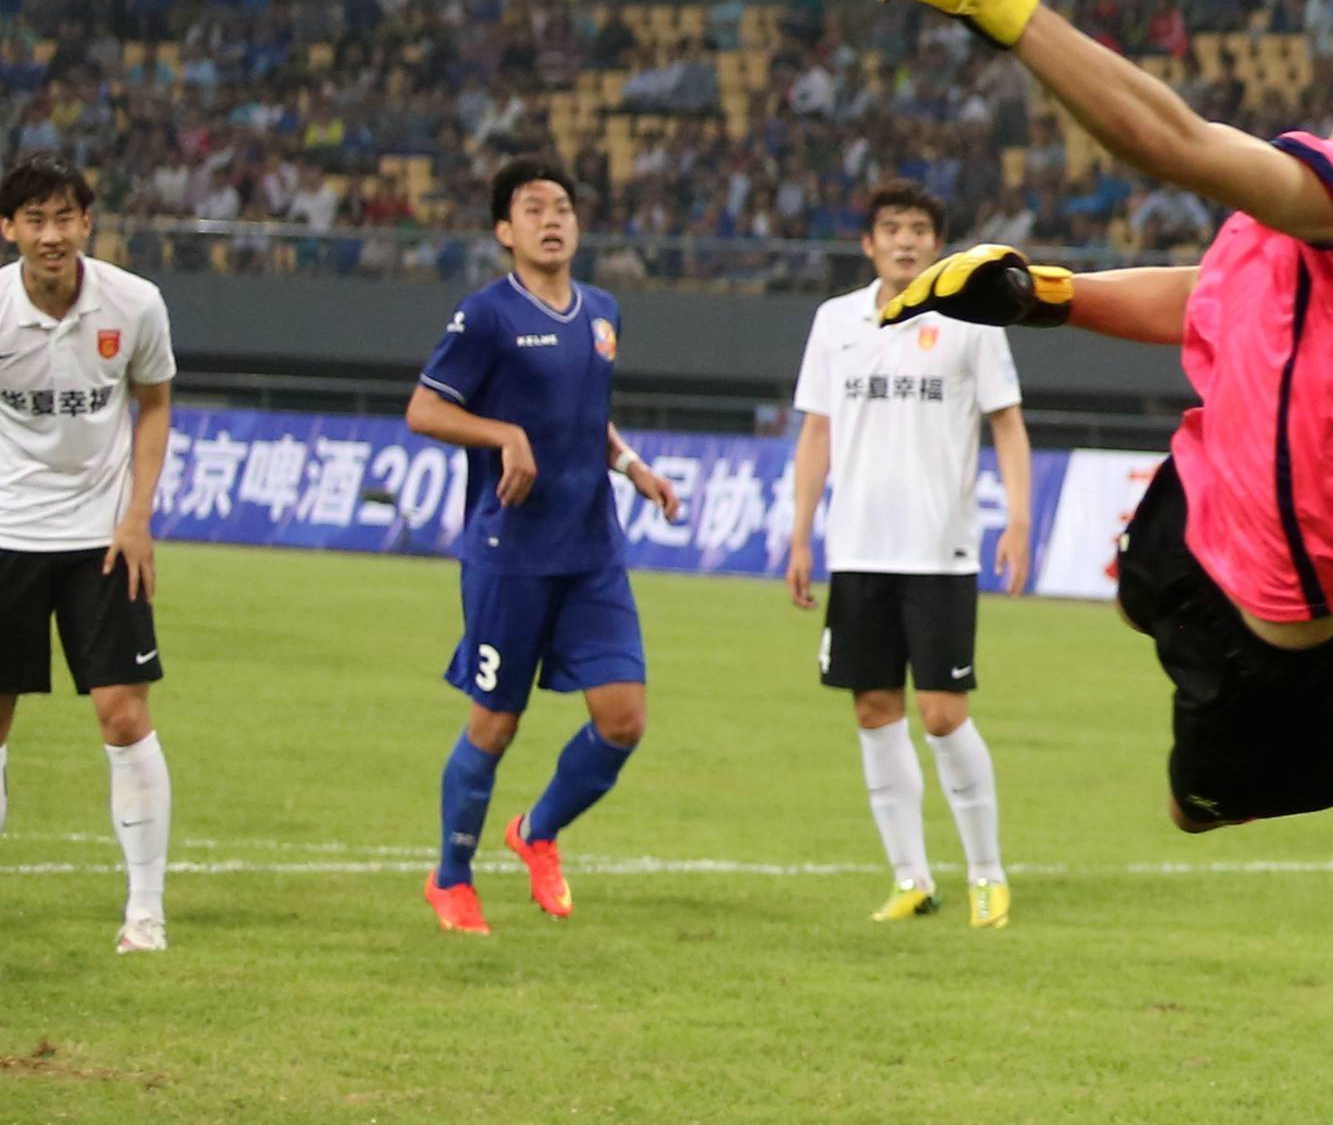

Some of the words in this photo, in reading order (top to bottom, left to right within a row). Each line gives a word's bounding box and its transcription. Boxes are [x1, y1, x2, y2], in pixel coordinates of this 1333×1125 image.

[844, 375, 943, 401] 华夏幸福
[475, 643, 501, 693] 3
